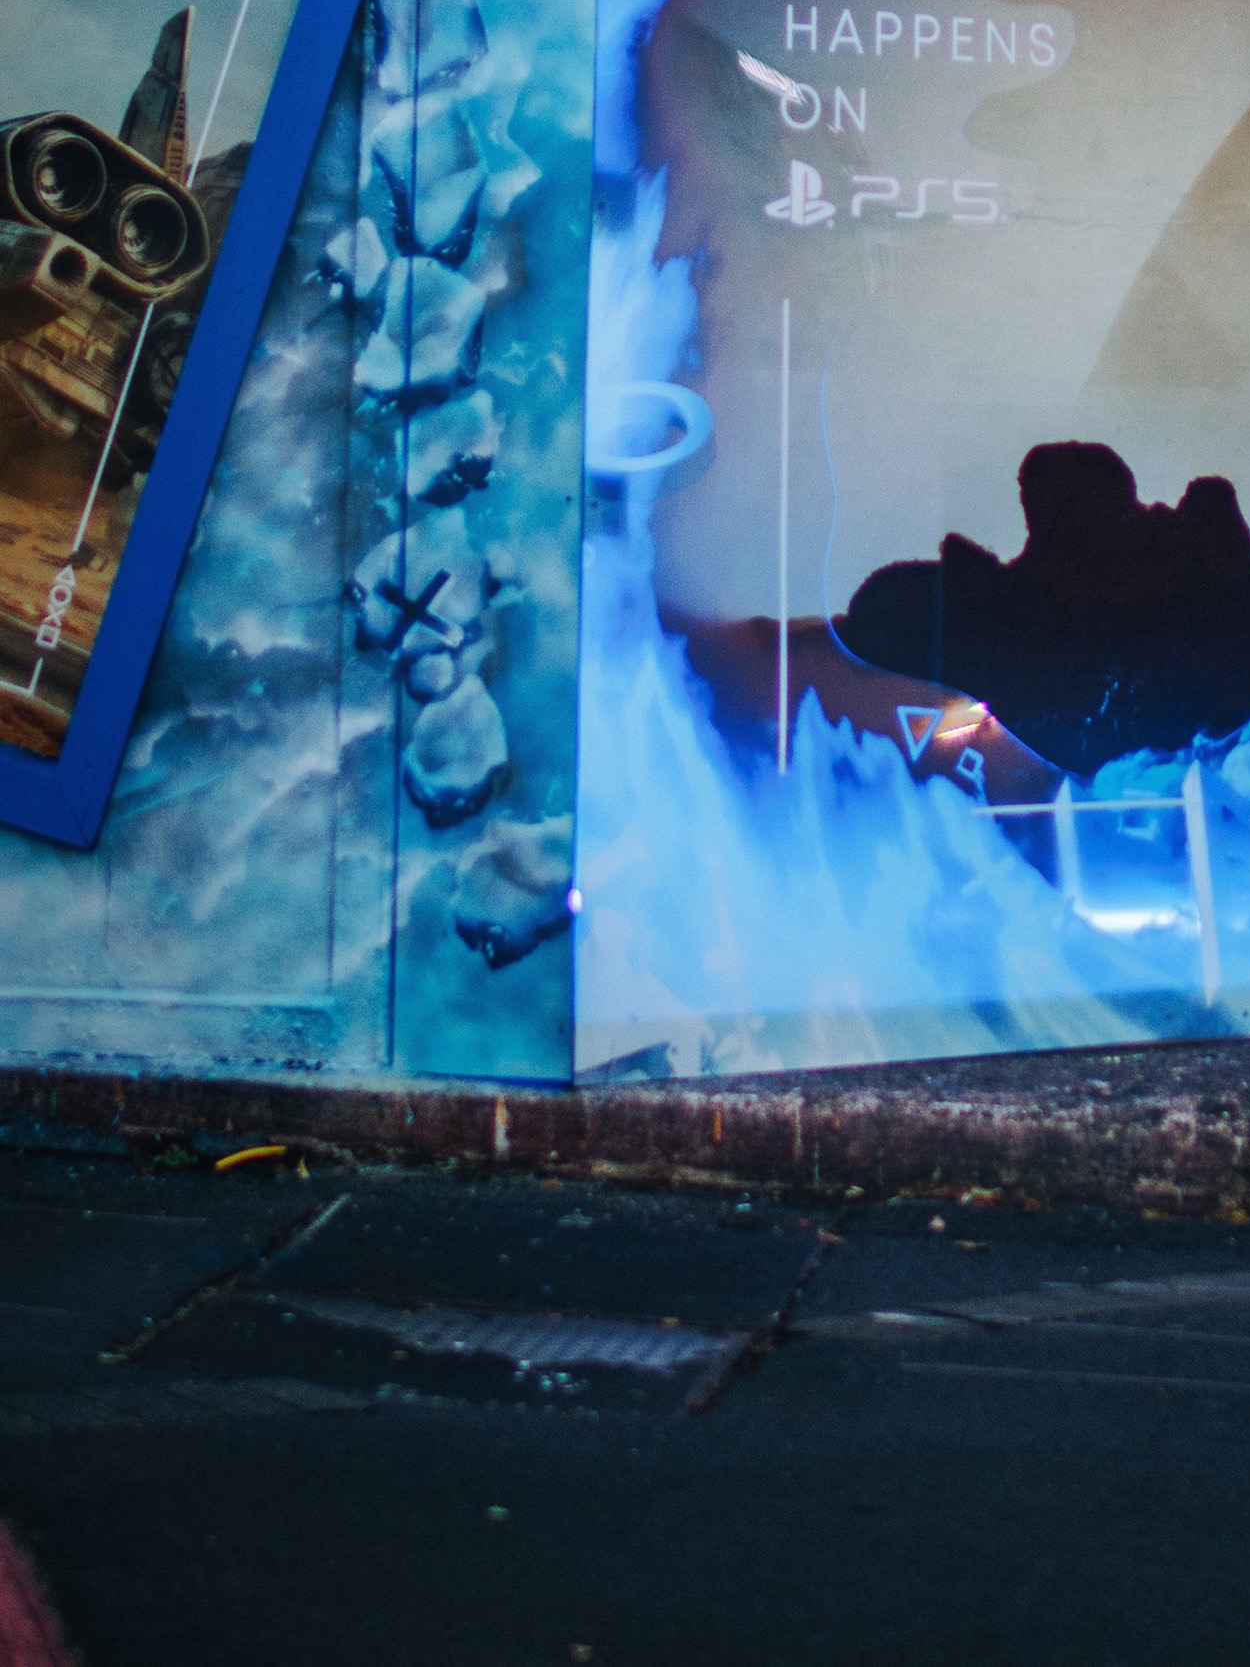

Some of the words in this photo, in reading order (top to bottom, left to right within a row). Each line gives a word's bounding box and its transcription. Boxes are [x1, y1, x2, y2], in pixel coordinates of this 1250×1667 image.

[785, 4, 1056, 67] HAPPENS
[780, 83, 867, 132] ON
[851, 174, 1000, 222] PS5
